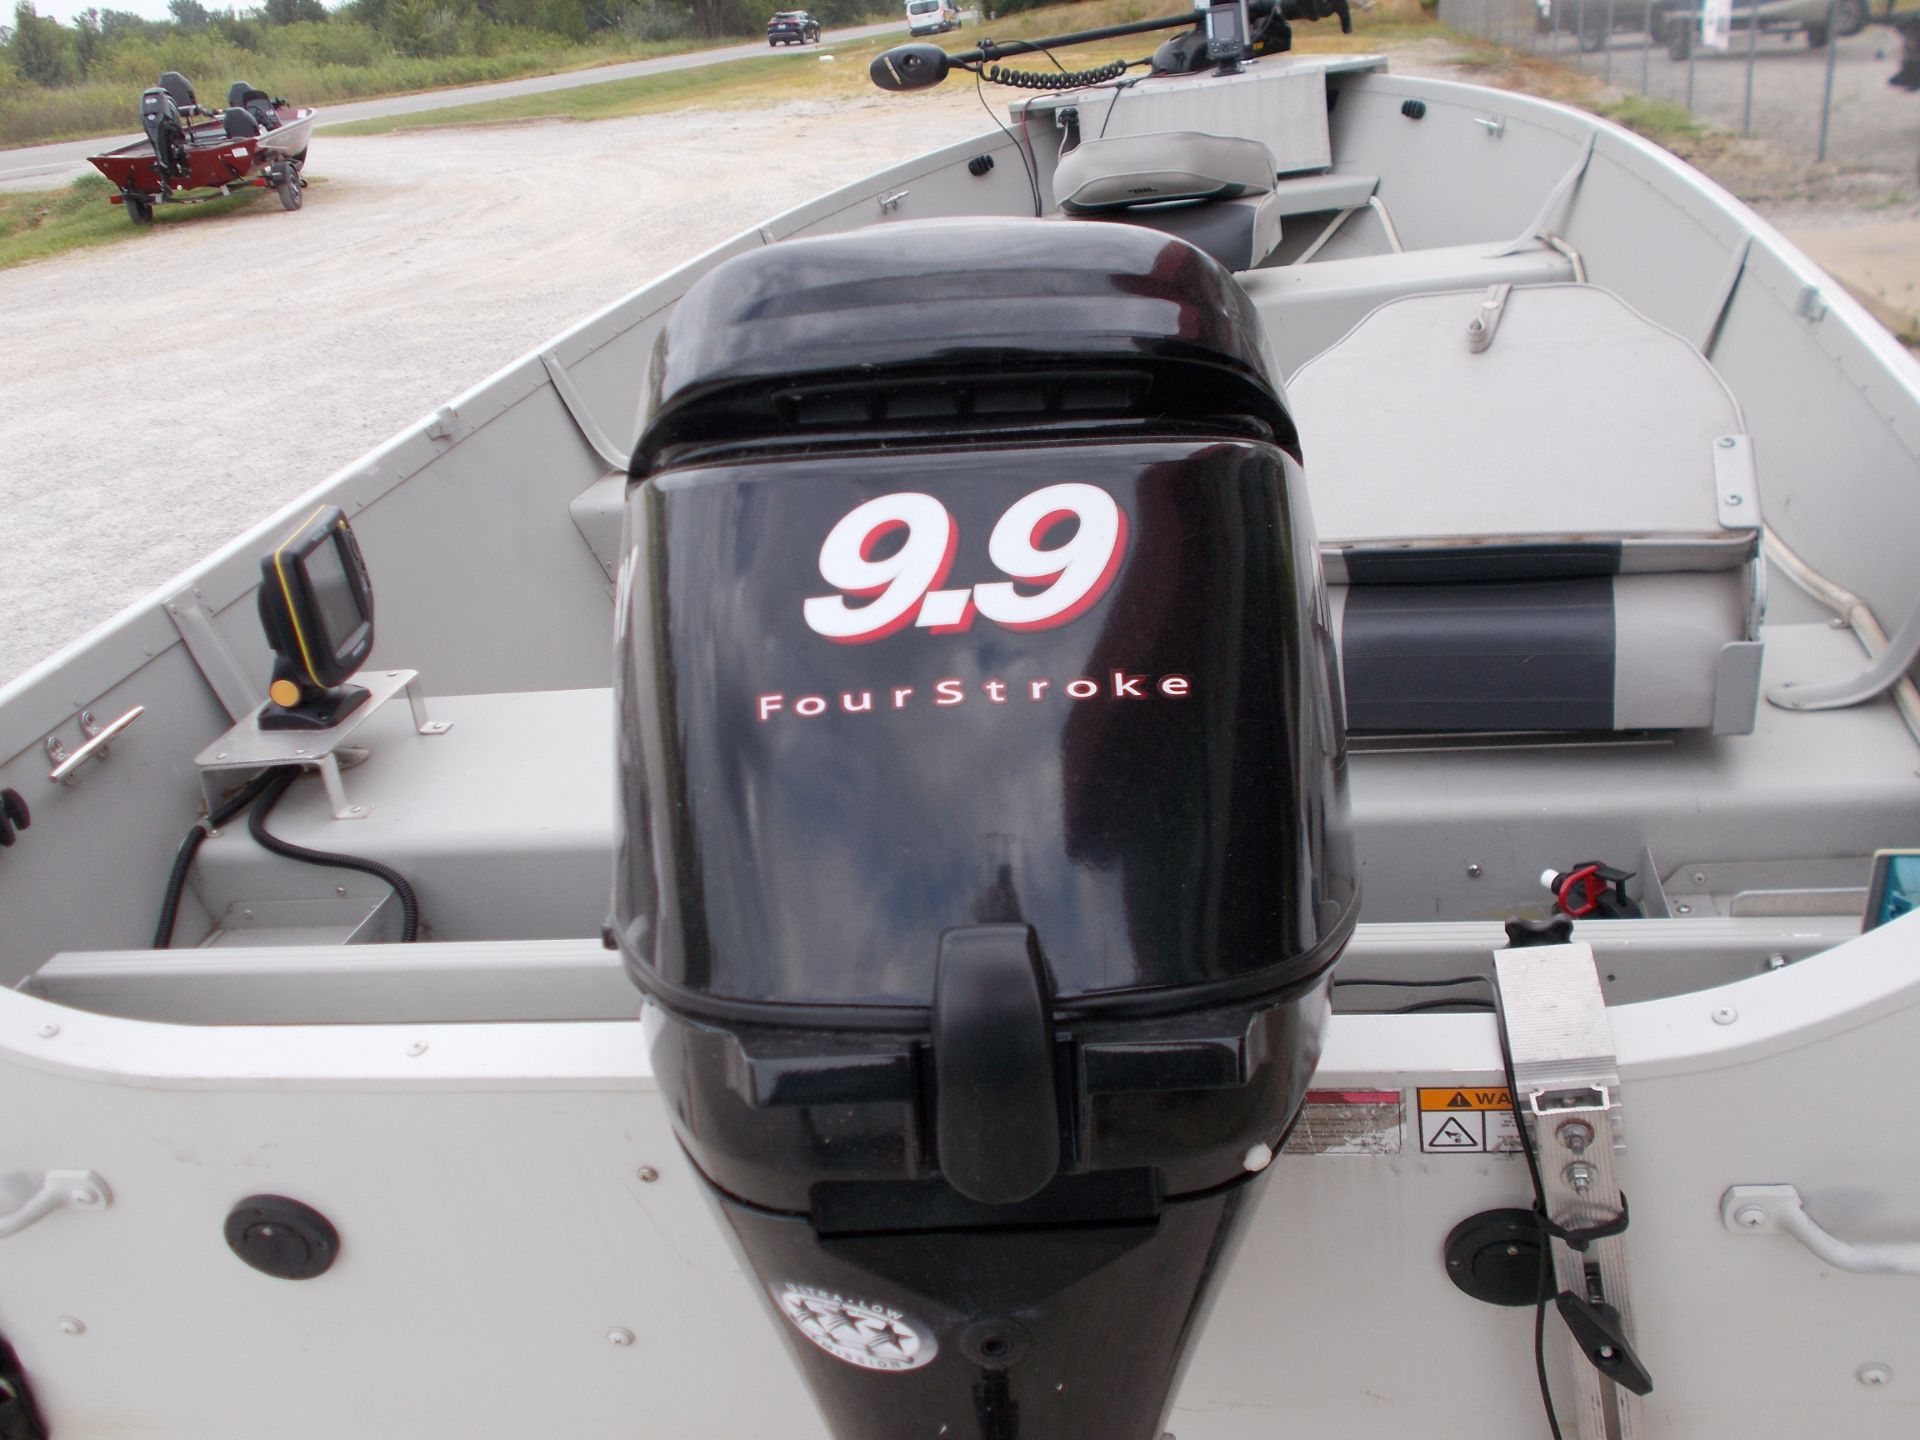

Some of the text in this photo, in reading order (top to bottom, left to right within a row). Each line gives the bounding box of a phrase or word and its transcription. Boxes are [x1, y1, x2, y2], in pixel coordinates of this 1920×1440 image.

[803, 482, 1128, 644] 9.9
[1475, 1092, 1513, 1104] WA
[858, 1299, 904, 1320] LOW
